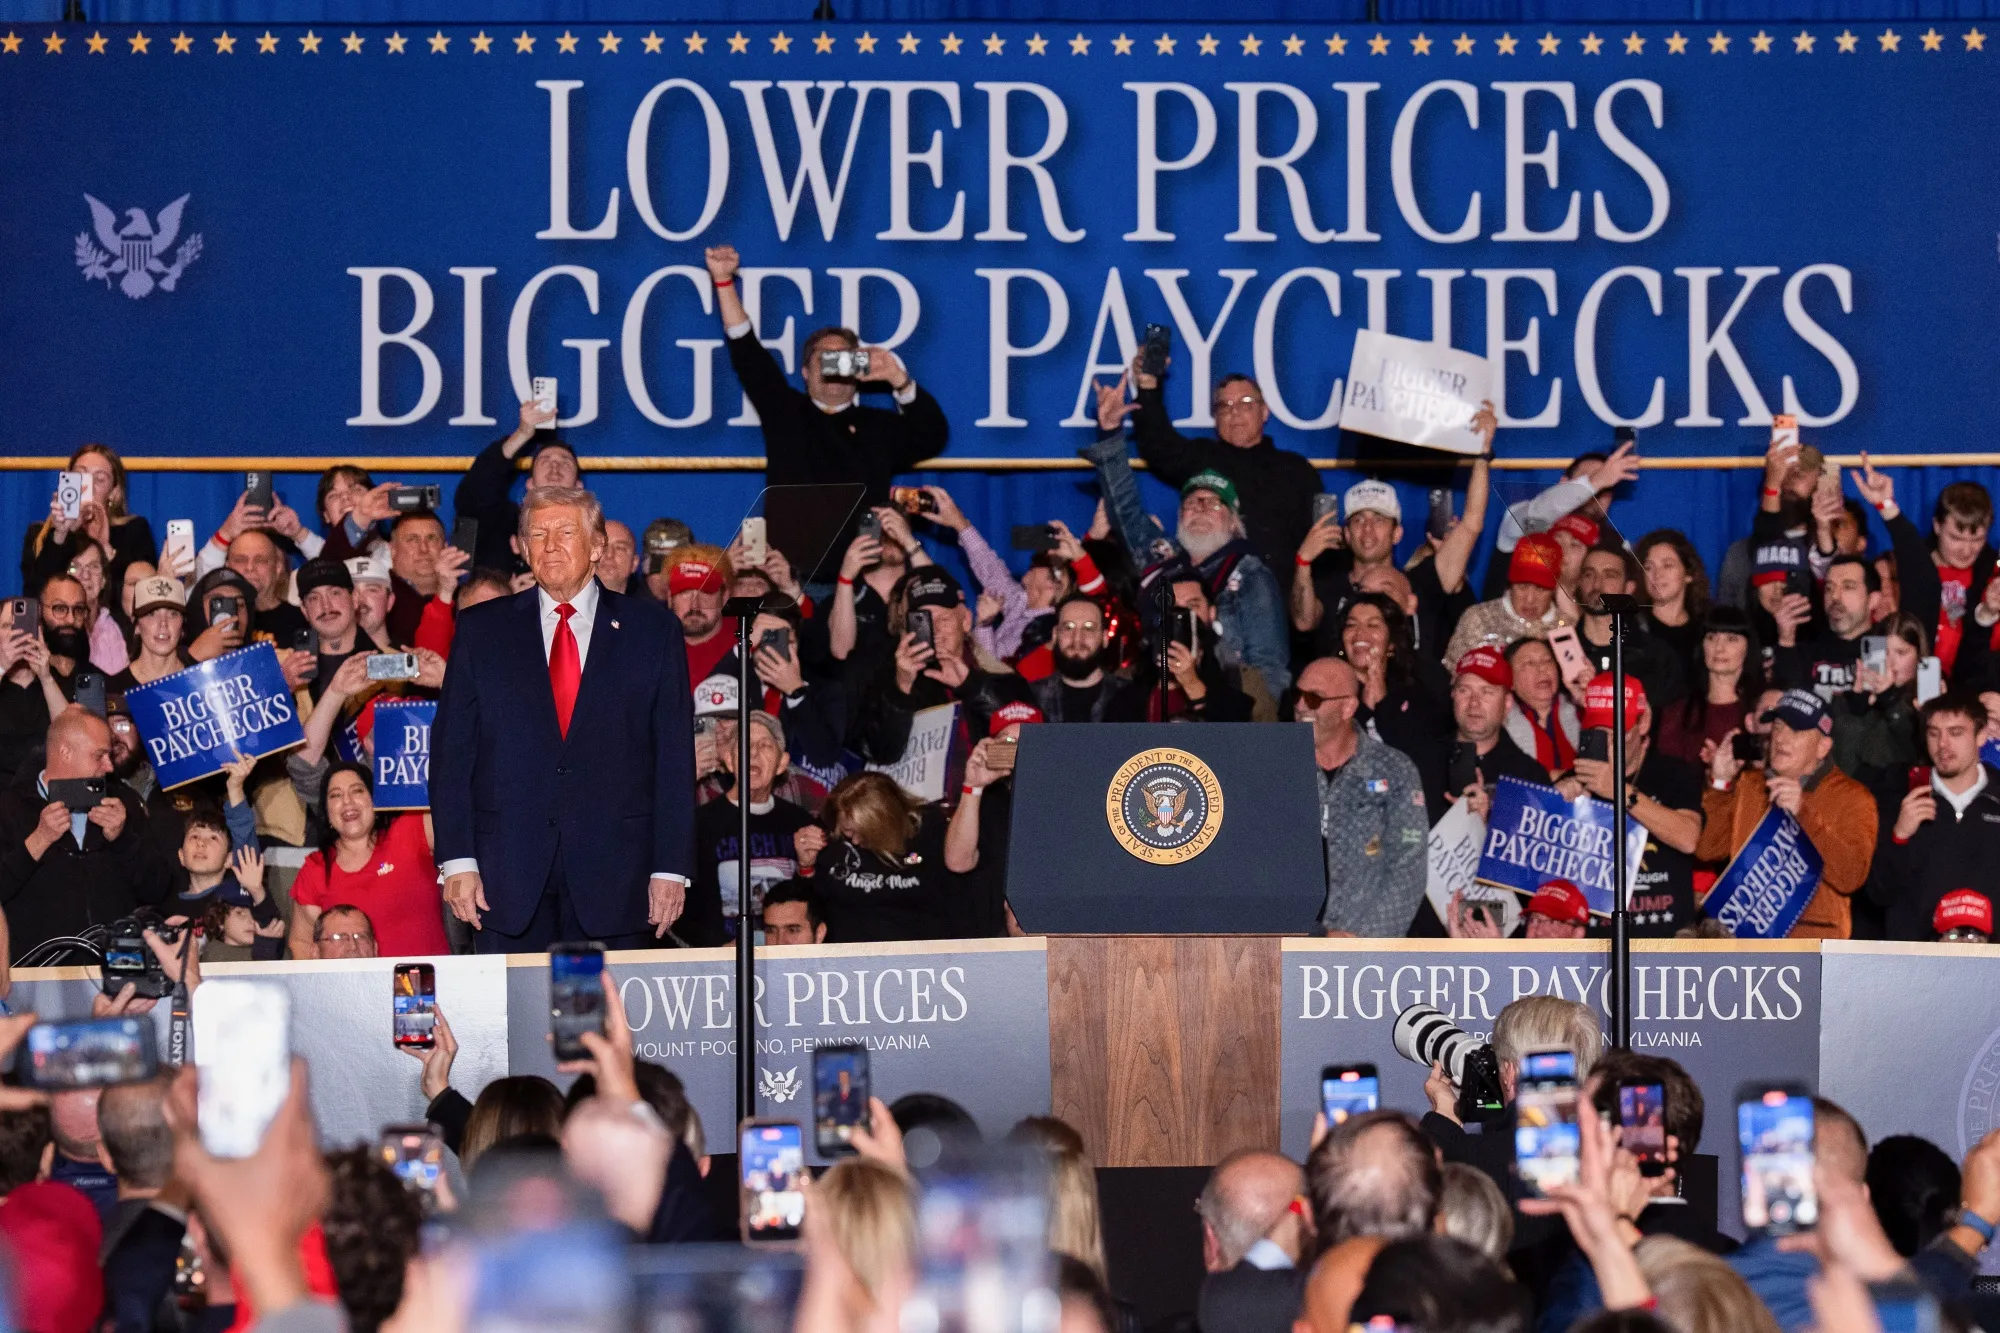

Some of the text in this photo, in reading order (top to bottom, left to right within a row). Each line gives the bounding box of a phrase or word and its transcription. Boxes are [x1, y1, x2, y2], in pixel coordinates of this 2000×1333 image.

[535, 78, 1671, 244] LOWER PRICES
[160, 674, 260, 731] BIGGER
[149, 693, 292, 767] PAYCHECKS
[1111, 752, 1163, 803] PRESIDENT
[1165, 753, 1177, 761] OF
[1178, 755, 1194, 768] THE
[1195, 765, 1220, 813] UNITED
[1125, 837, 1155, 859] SEAL
[1175, 823, 1215, 859] STATES
[1518, 805, 1613, 859] BIGGER
[846, 872, 920, 893] Angel Mom
[1486, 828, 1615, 892] PAYCHECK
[1629, 895, 1674, 912] UMP
[1745, 847, 1809, 934] BIGGER
[619, 967, 968, 1033] OWER PRICES
[1299, 965, 1496, 1020] BIGGER
[700, 1037, 788, 1057] POCNO,
